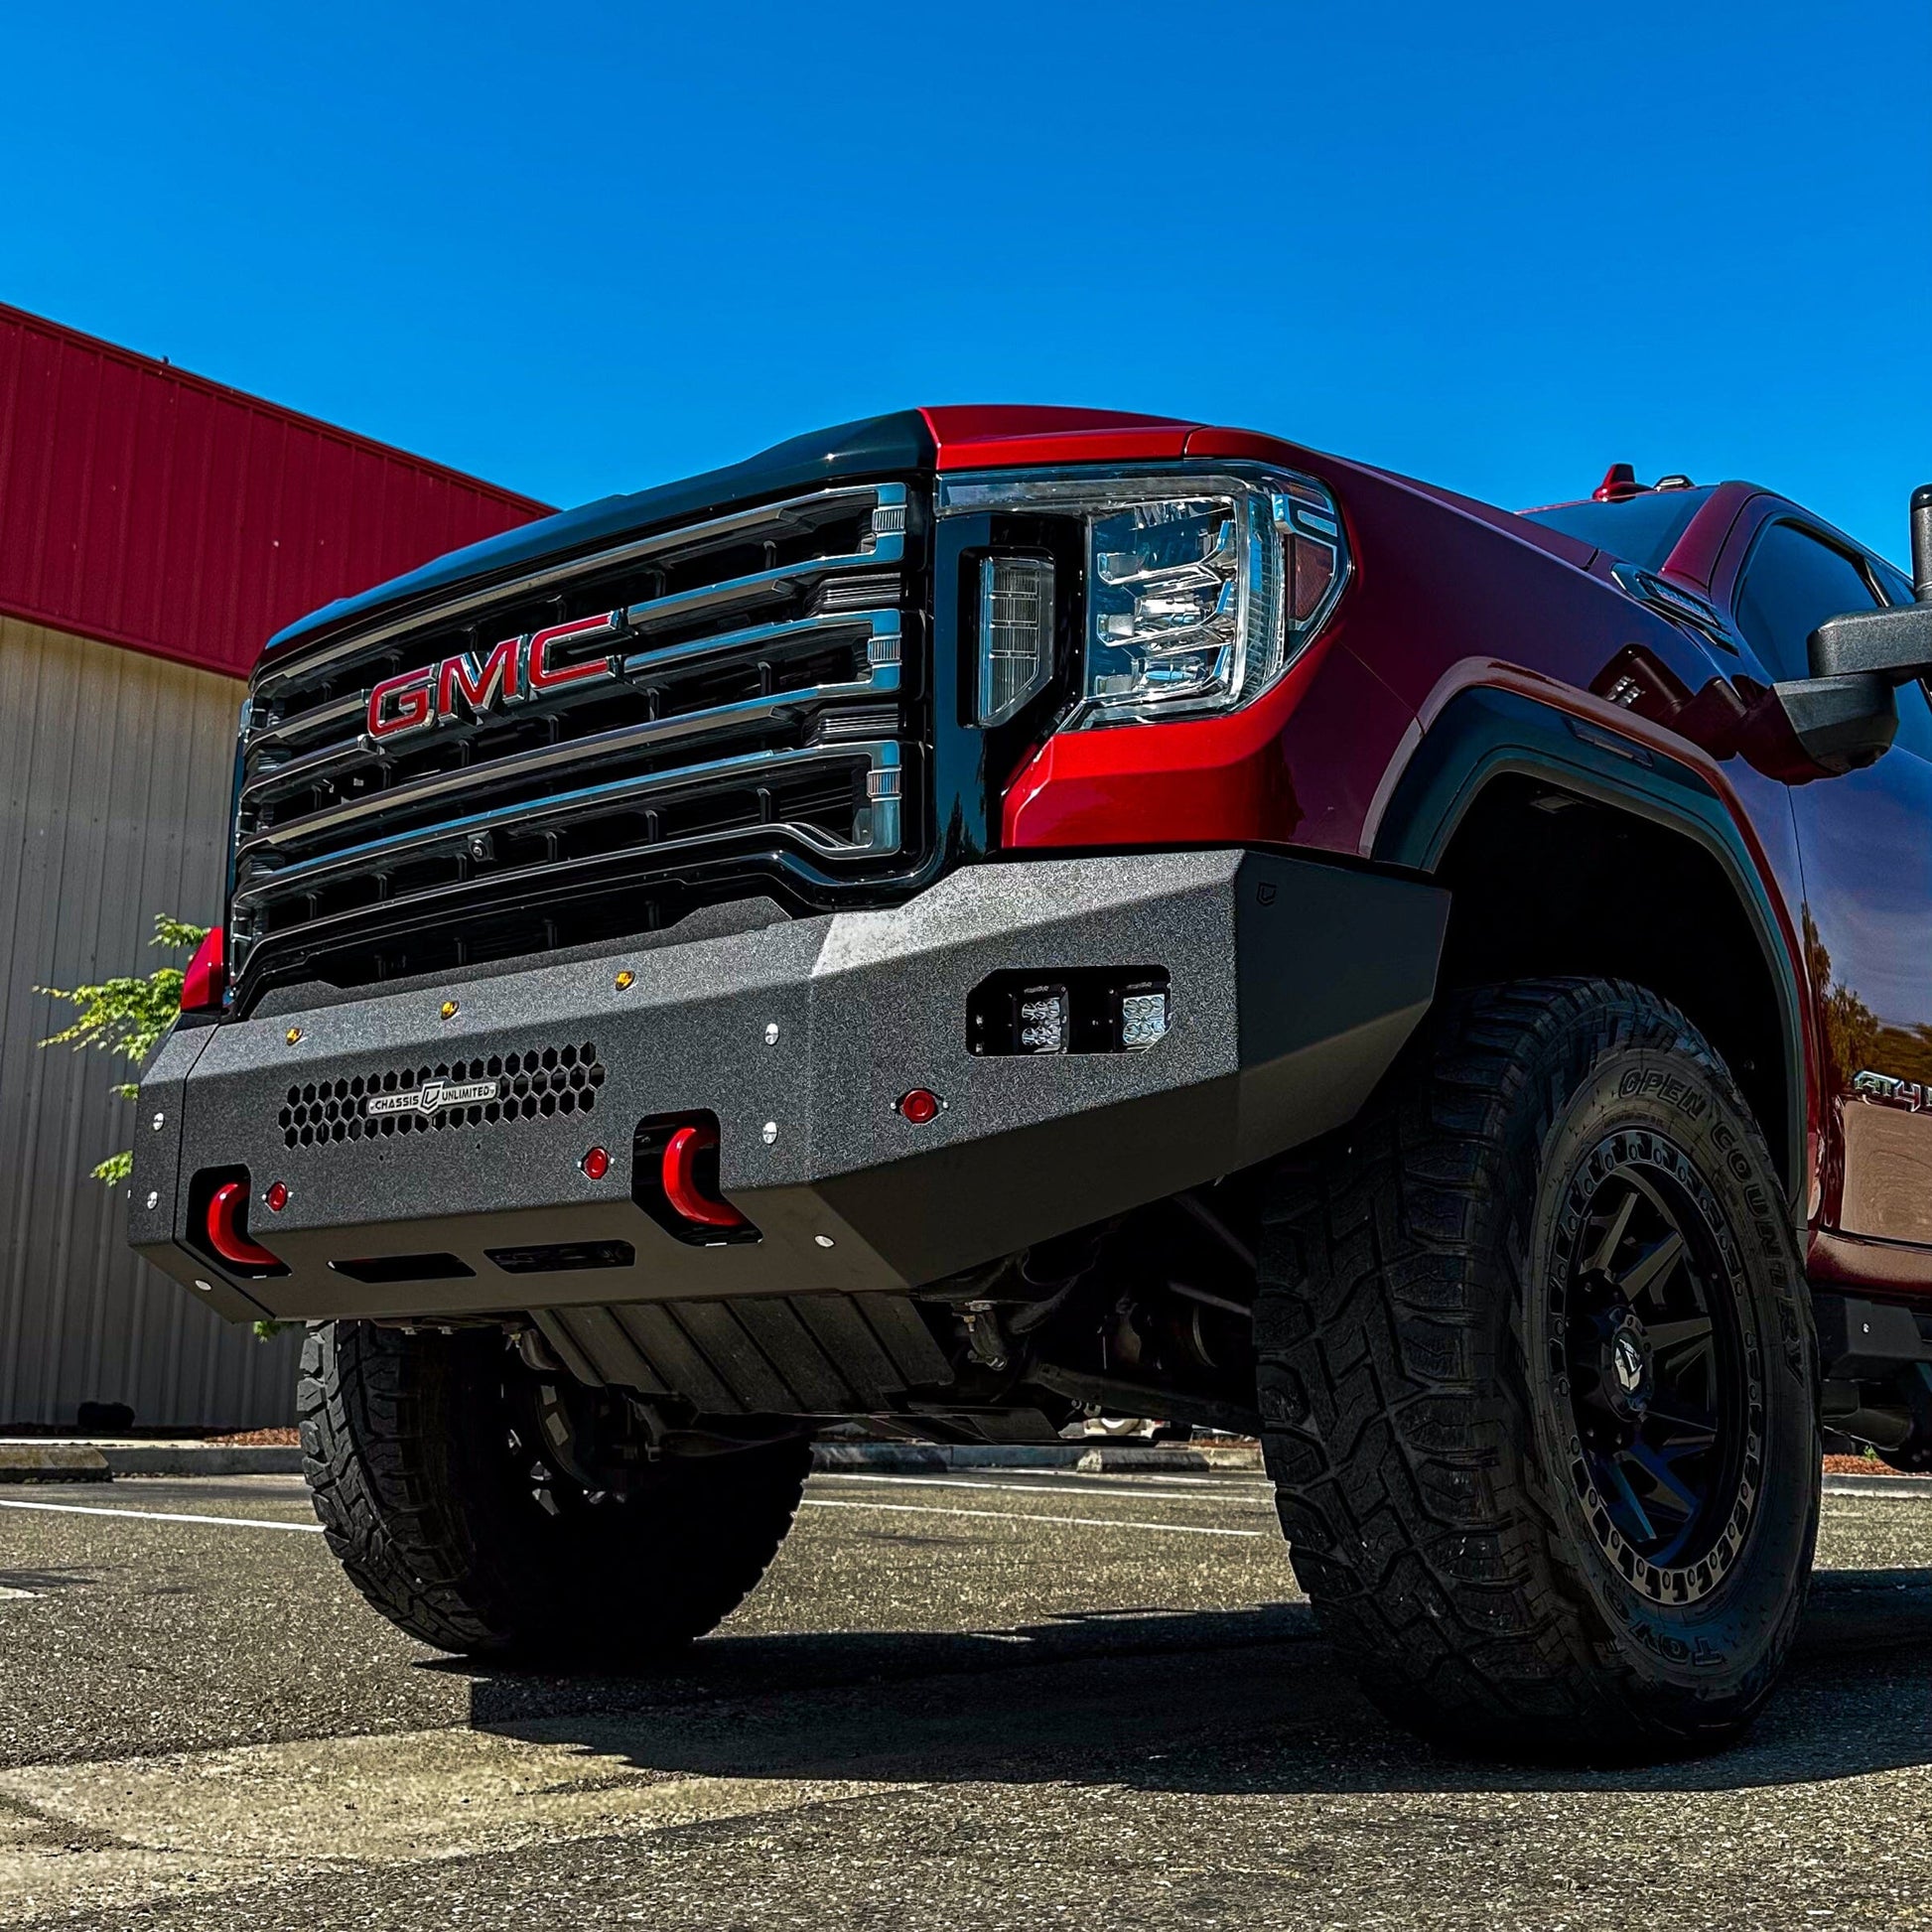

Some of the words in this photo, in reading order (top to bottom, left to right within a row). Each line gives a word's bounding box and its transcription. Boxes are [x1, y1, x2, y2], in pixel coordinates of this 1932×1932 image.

[367, 608, 623, 741] GMC
[374, 1095, 419, 1111] CHASSIS
[442, 1085, 489, 1102] UNLIMITED
[1618, 1067, 1709, 1122] OPEN
